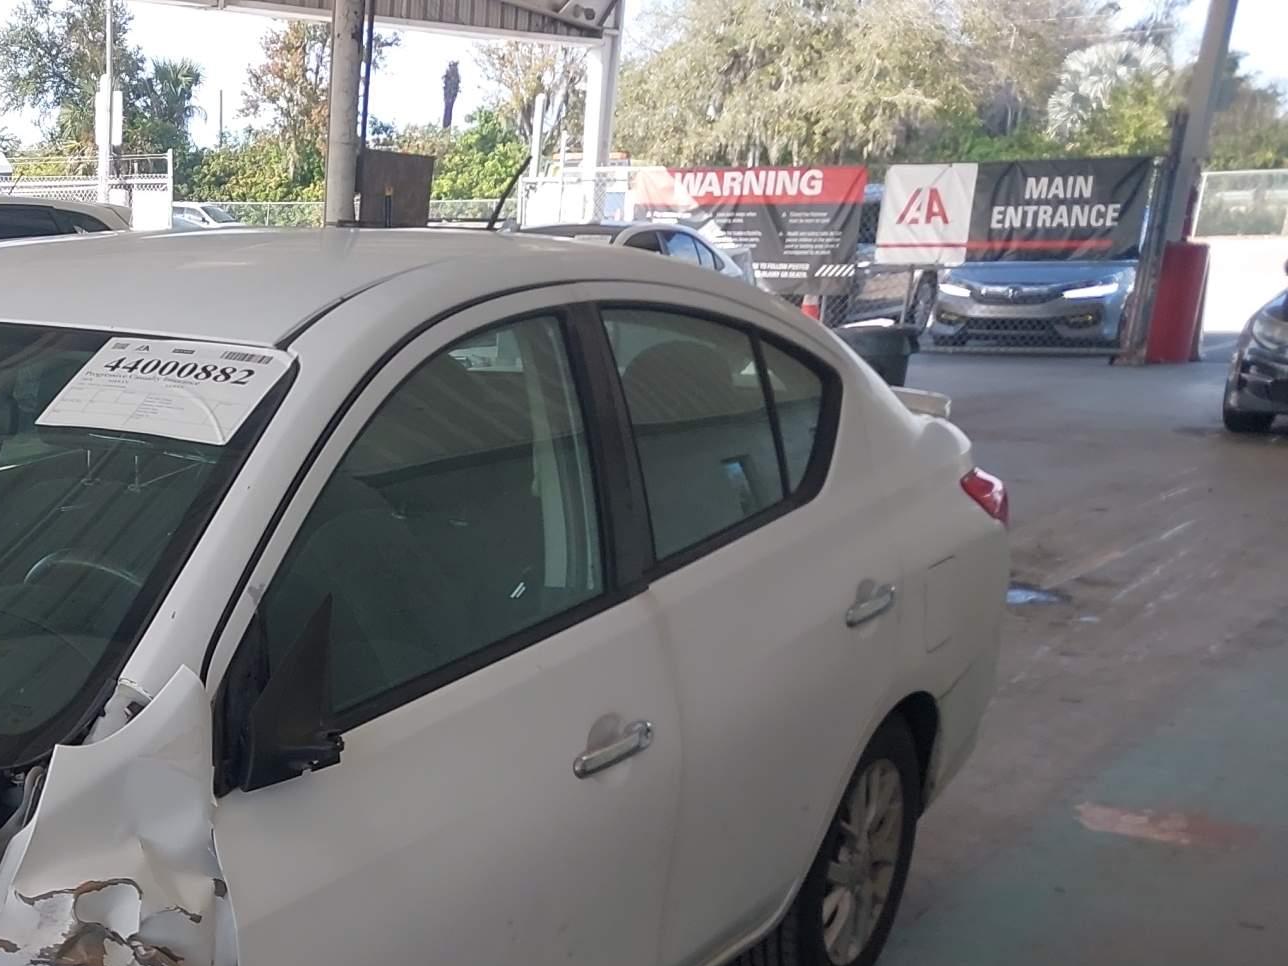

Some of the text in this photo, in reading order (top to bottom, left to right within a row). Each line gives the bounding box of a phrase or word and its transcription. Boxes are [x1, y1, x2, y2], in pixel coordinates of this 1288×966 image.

[674, 169, 823, 197] WARNING
[1024, 175, 1094, 199] MAIN
[990, 204, 1121, 229] ENTRANCE
[104, 356, 256, 386] 44000882
